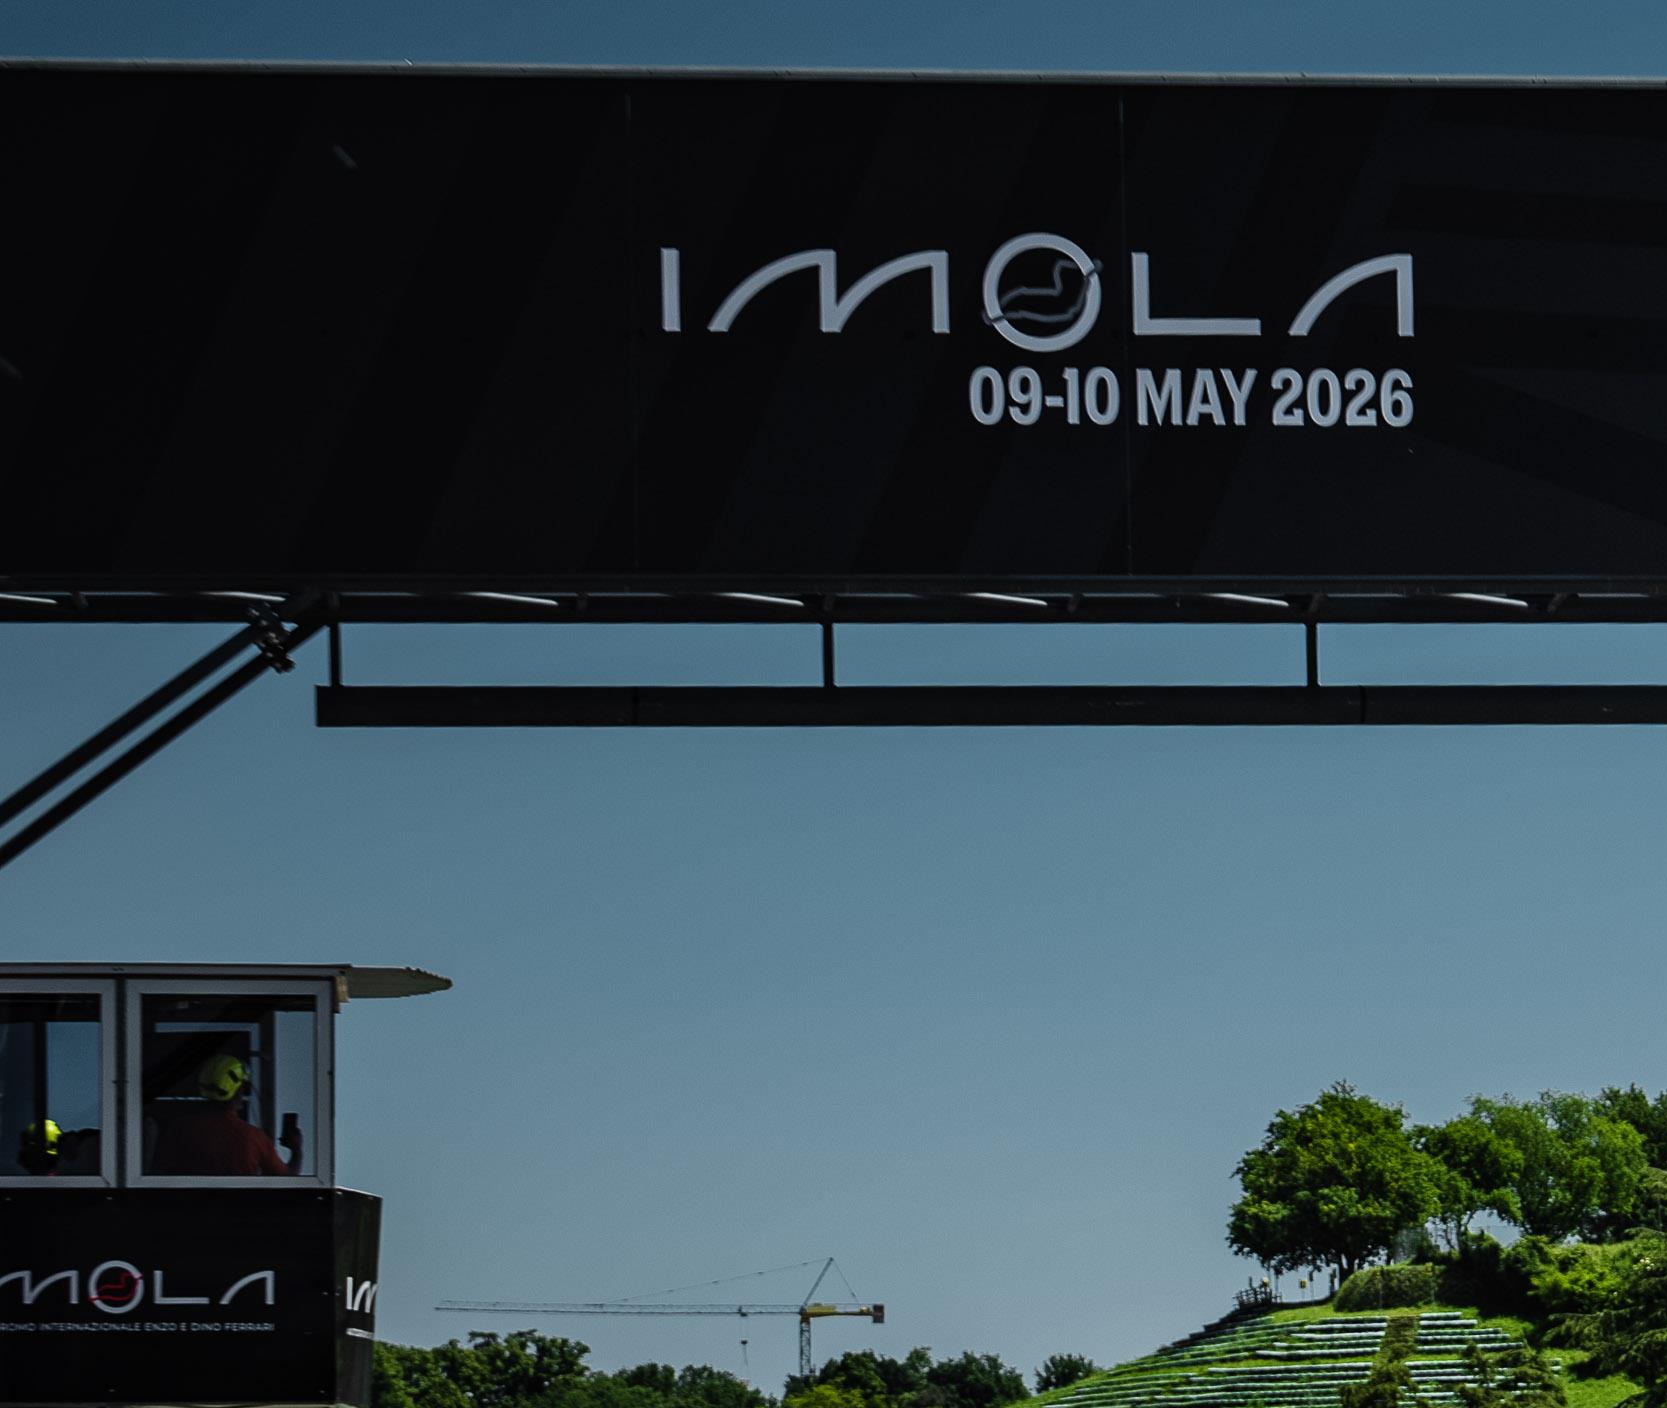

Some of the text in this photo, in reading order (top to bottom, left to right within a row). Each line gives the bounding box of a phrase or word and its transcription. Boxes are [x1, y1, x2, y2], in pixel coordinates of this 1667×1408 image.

[660, 232, 1415, 353] IMOLA
[969, 366, 1414, 428] 09-10 MAY 2026
[0, 1260, 275, 1314] MOLA
